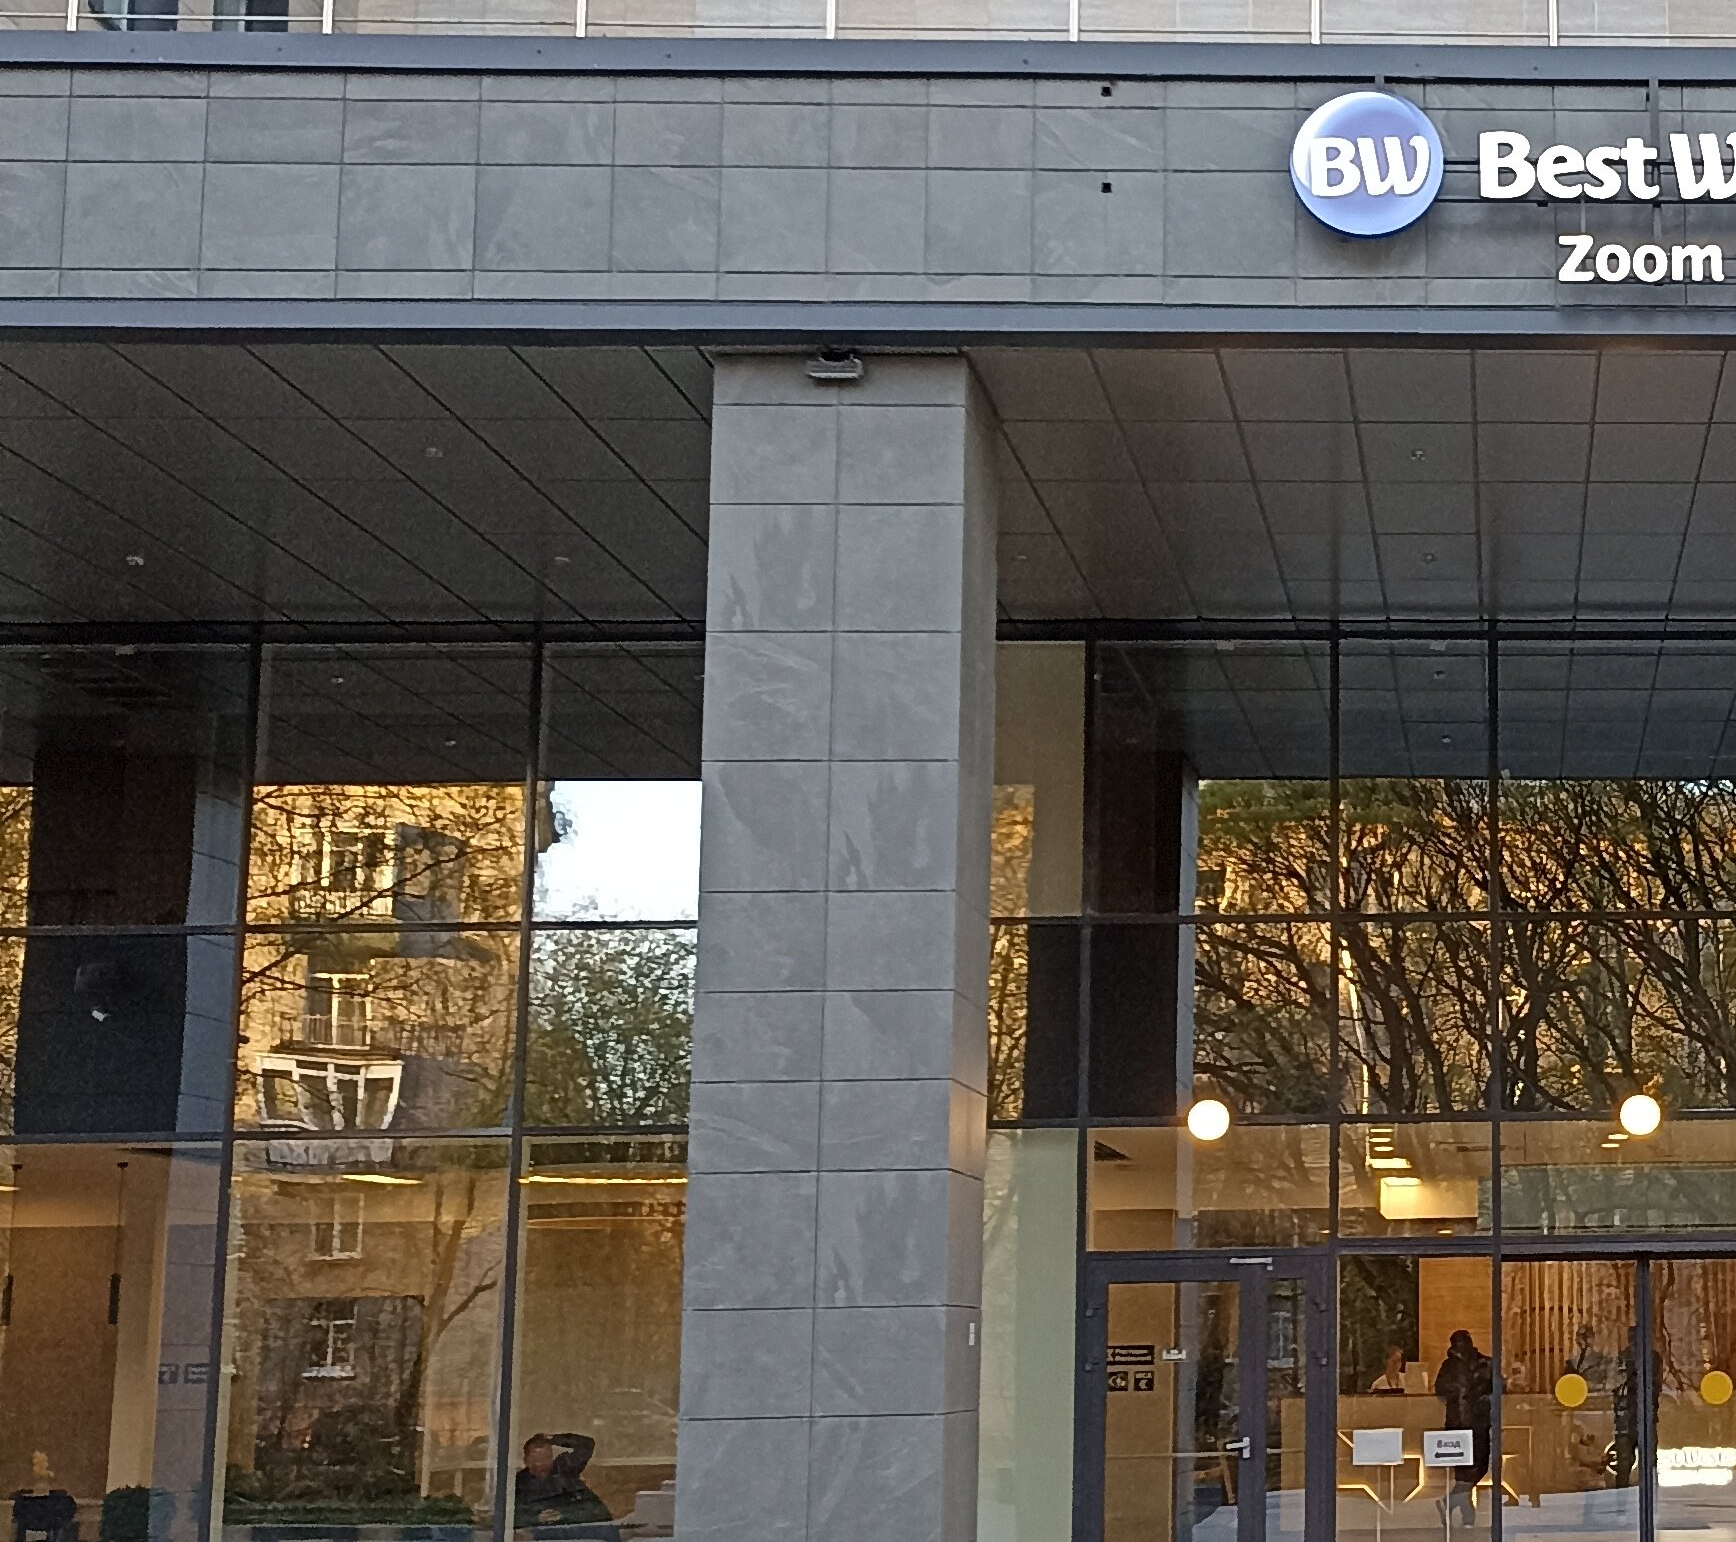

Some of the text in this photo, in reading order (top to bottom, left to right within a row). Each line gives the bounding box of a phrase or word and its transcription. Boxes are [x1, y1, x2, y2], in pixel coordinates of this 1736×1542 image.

[1310, 135, 1430, 197] BW
[1478, 130, 1660, 200] Best
[1558, 234, 1725, 283] Zoom
